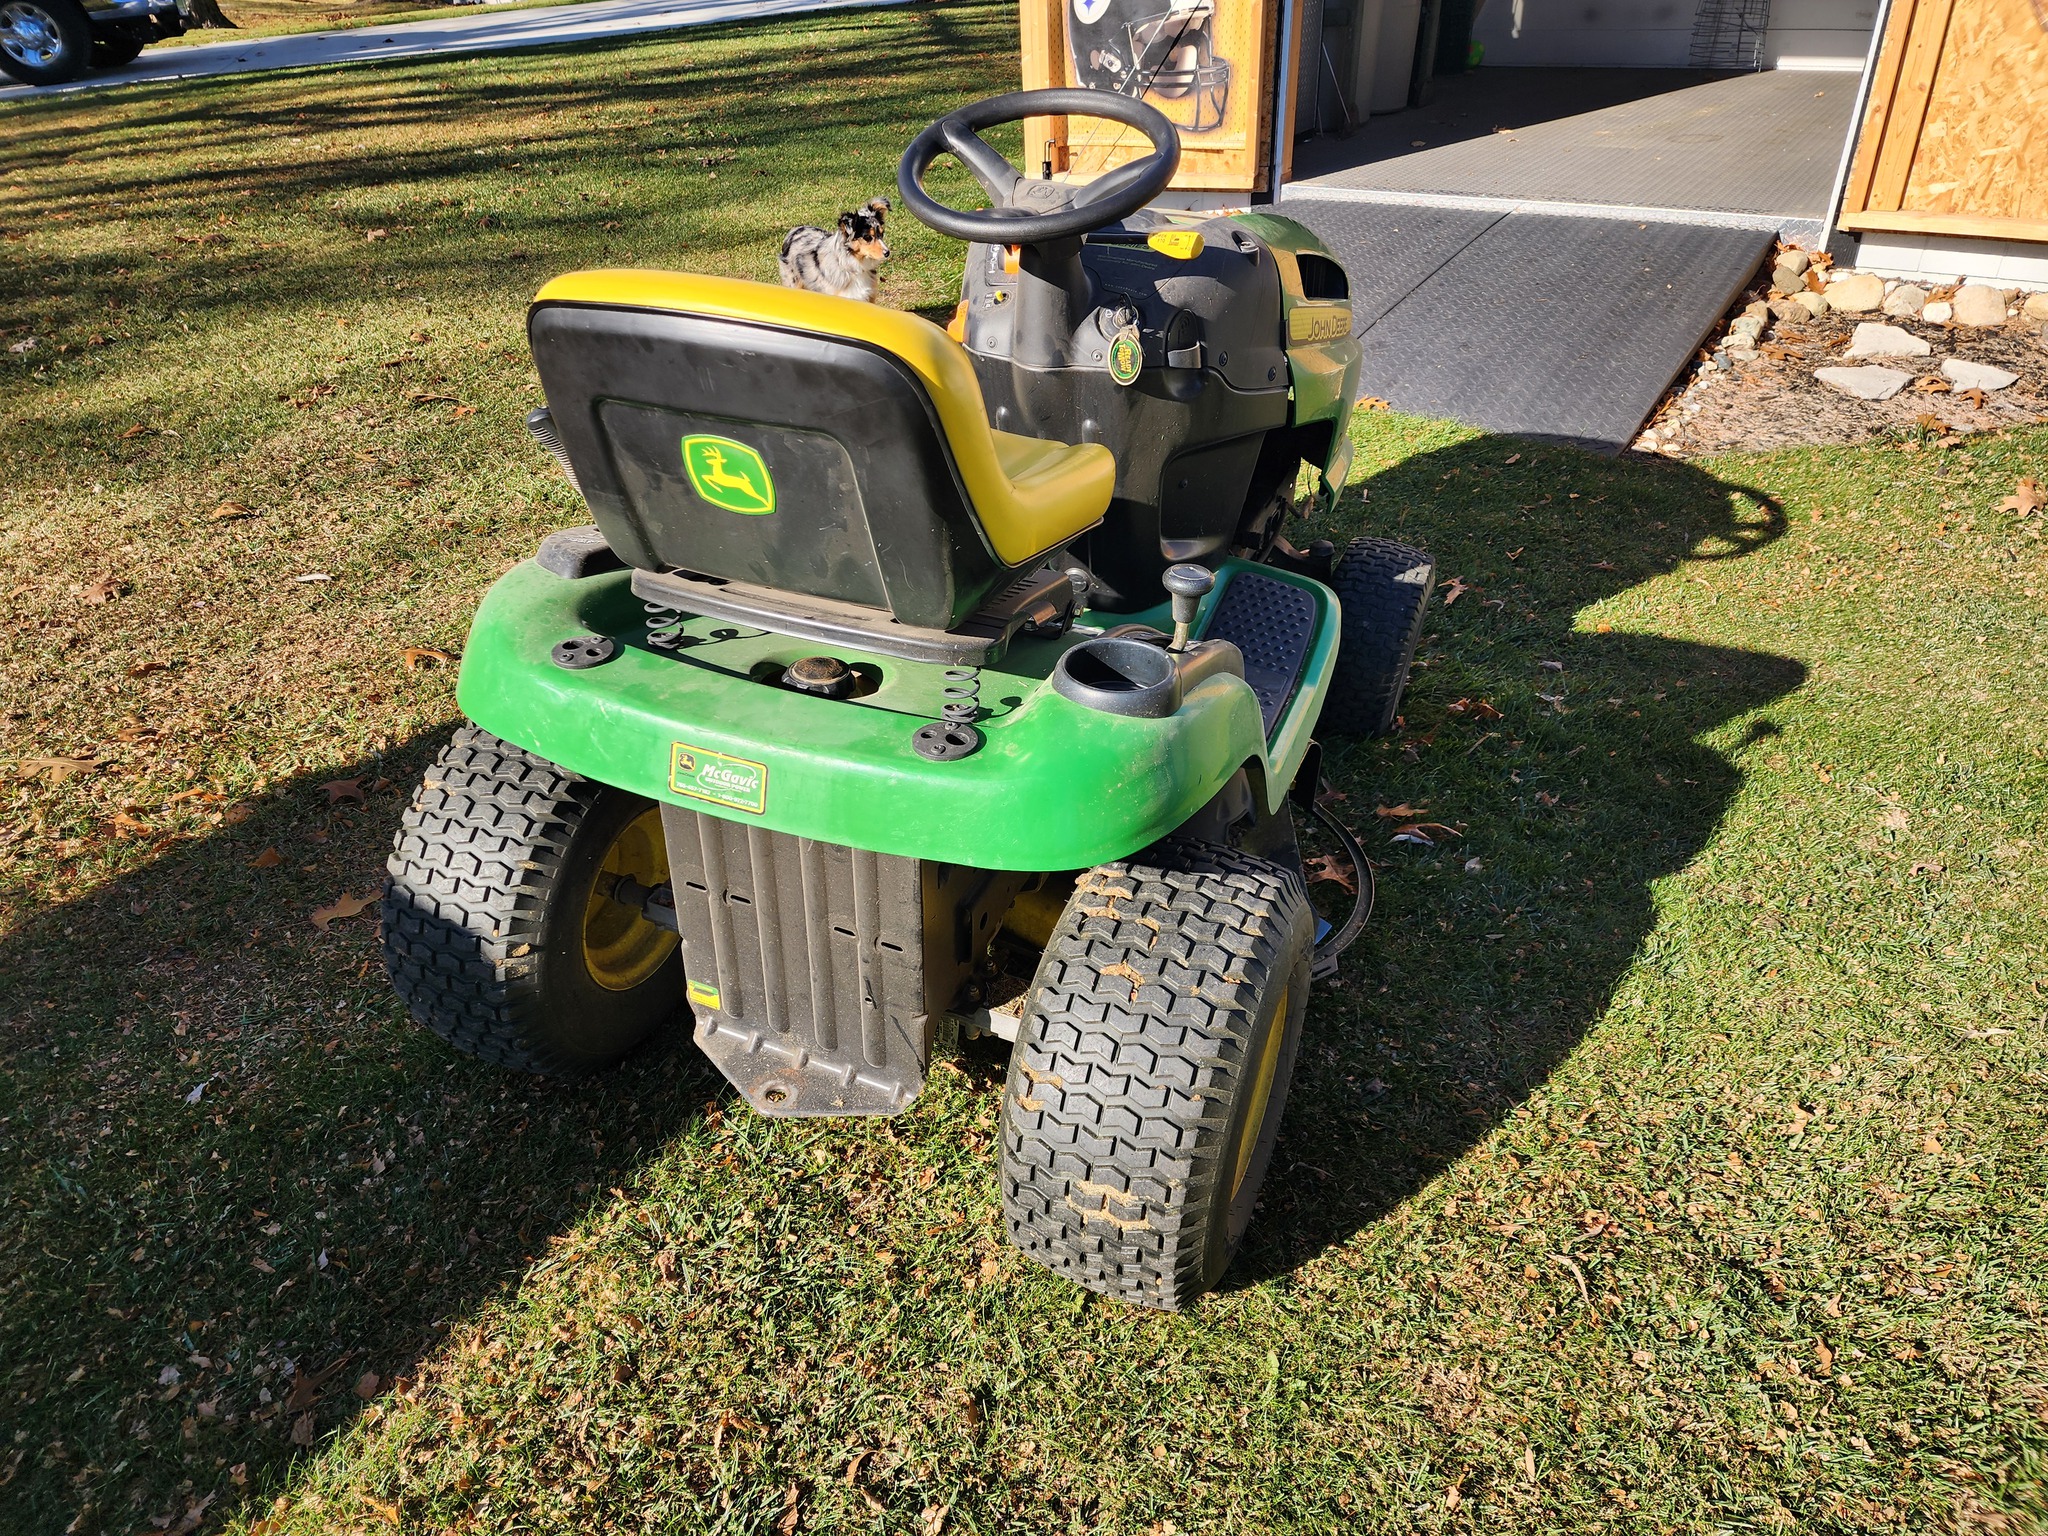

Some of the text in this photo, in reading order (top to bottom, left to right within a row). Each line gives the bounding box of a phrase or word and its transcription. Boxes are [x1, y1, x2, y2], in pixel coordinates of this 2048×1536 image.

[1308, 315, 1348, 338] JOHN DEERE
[701, 763, 759, 789] McGavic
[731, 783, 751, 793] POWER
